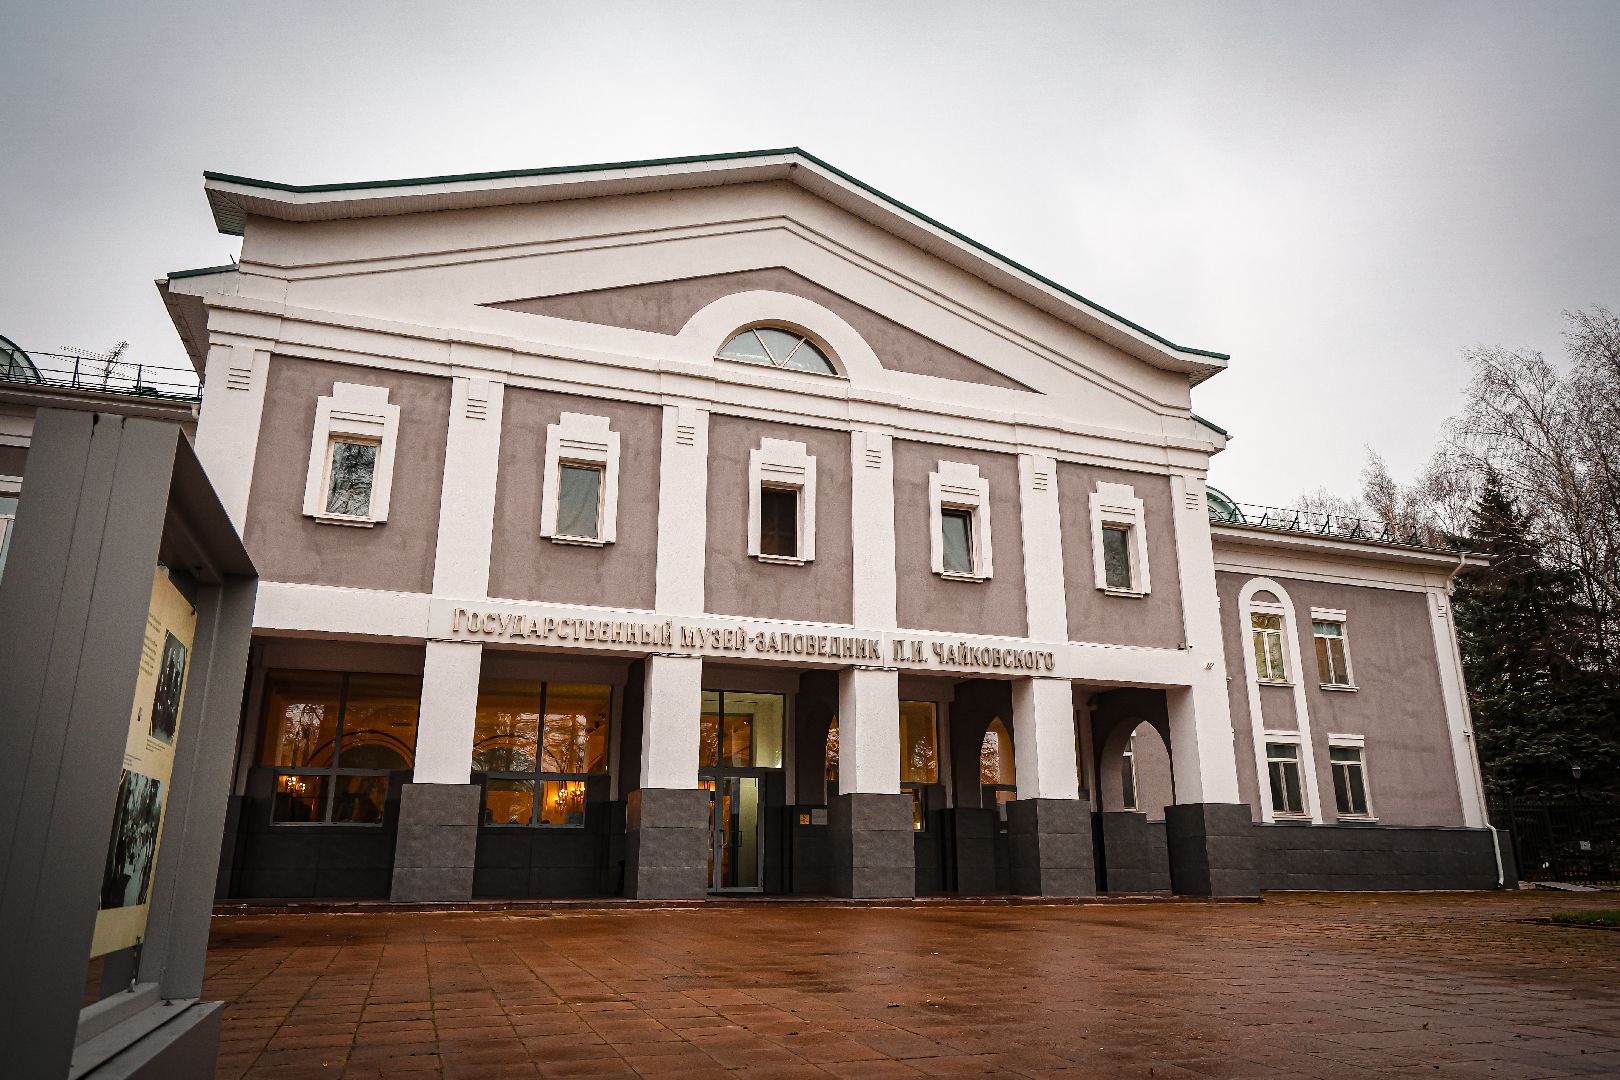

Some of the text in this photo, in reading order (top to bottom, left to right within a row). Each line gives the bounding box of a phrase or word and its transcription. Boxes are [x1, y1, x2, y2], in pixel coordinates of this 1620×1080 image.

[452, 608, 1056, 671] ГОСУДАРСТВЕННЫЙ МУЗЕЙ-ЗАПОВЕДНИК П.И. ЧАЙКОВСКОГО
